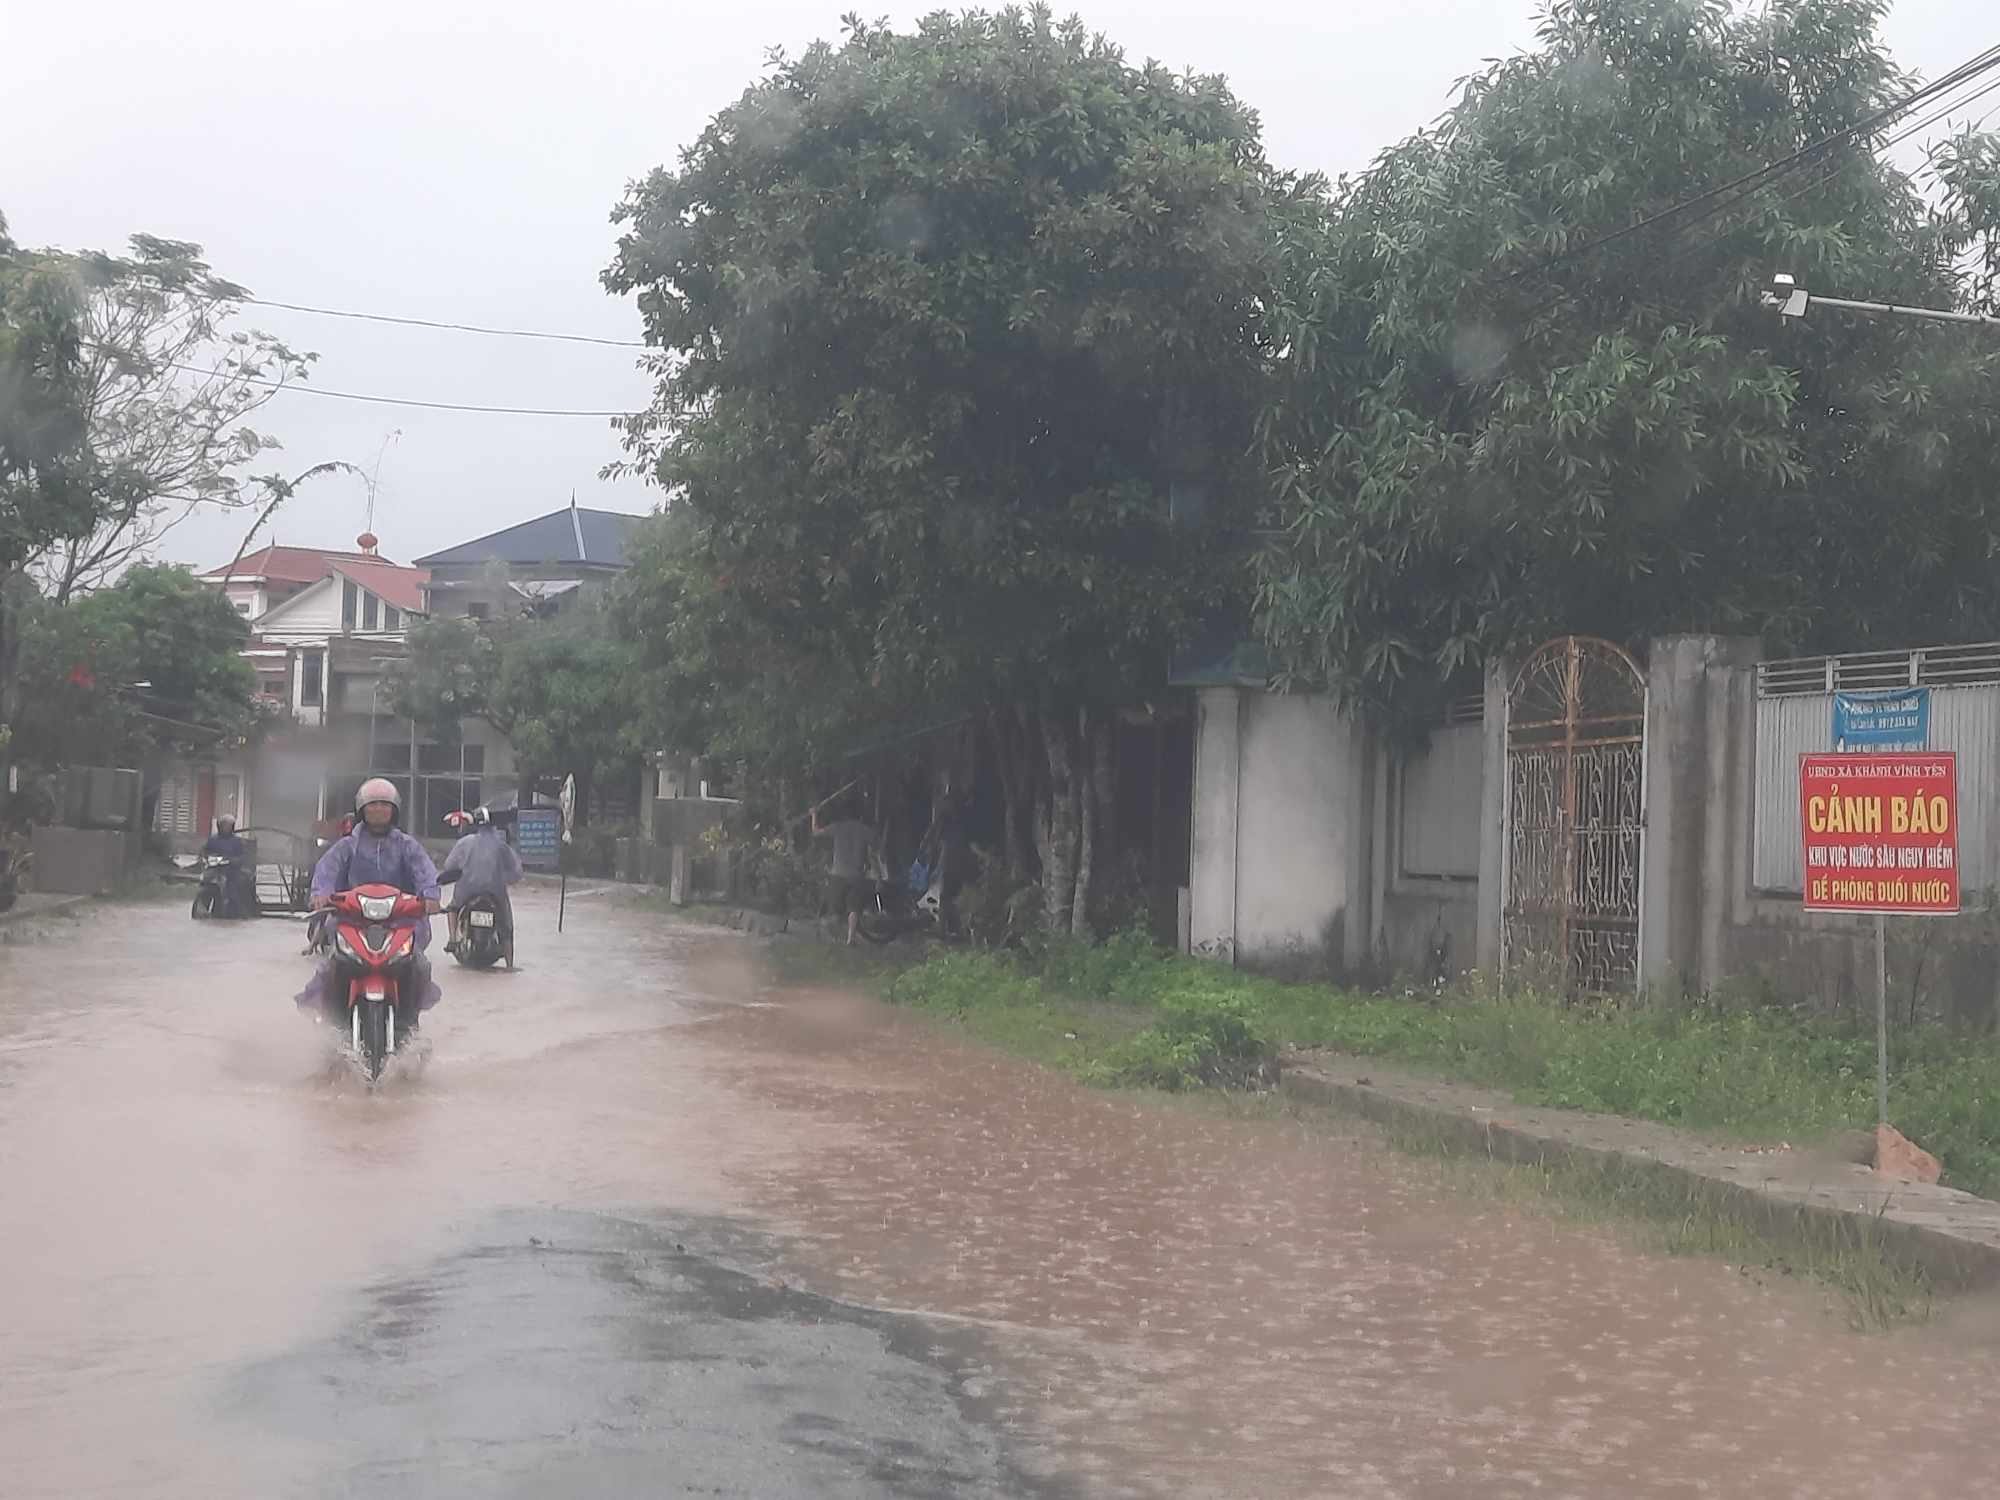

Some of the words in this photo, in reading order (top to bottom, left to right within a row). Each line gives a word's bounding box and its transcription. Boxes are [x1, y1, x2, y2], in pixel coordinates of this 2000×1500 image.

[1809, 784, 1882, 834] CẢNH
[1890, 788, 1949, 834] BÁO
[1808, 846, 1827, 866] KHU
[1829, 844, 1847, 872] VỰC
[1849, 843, 1874, 868] NƯỚC
[1876, 844, 1896, 869] SÂU
[1898, 847, 1923, 869] NGUY
[1926, 839, 1953, 869] HIỂM
[1832, 876, 1874, 902] PHÒNG
[1877, 875, 1908, 903] ĐUỐI
[1912, 878, 1950, 903] NƯỚC
